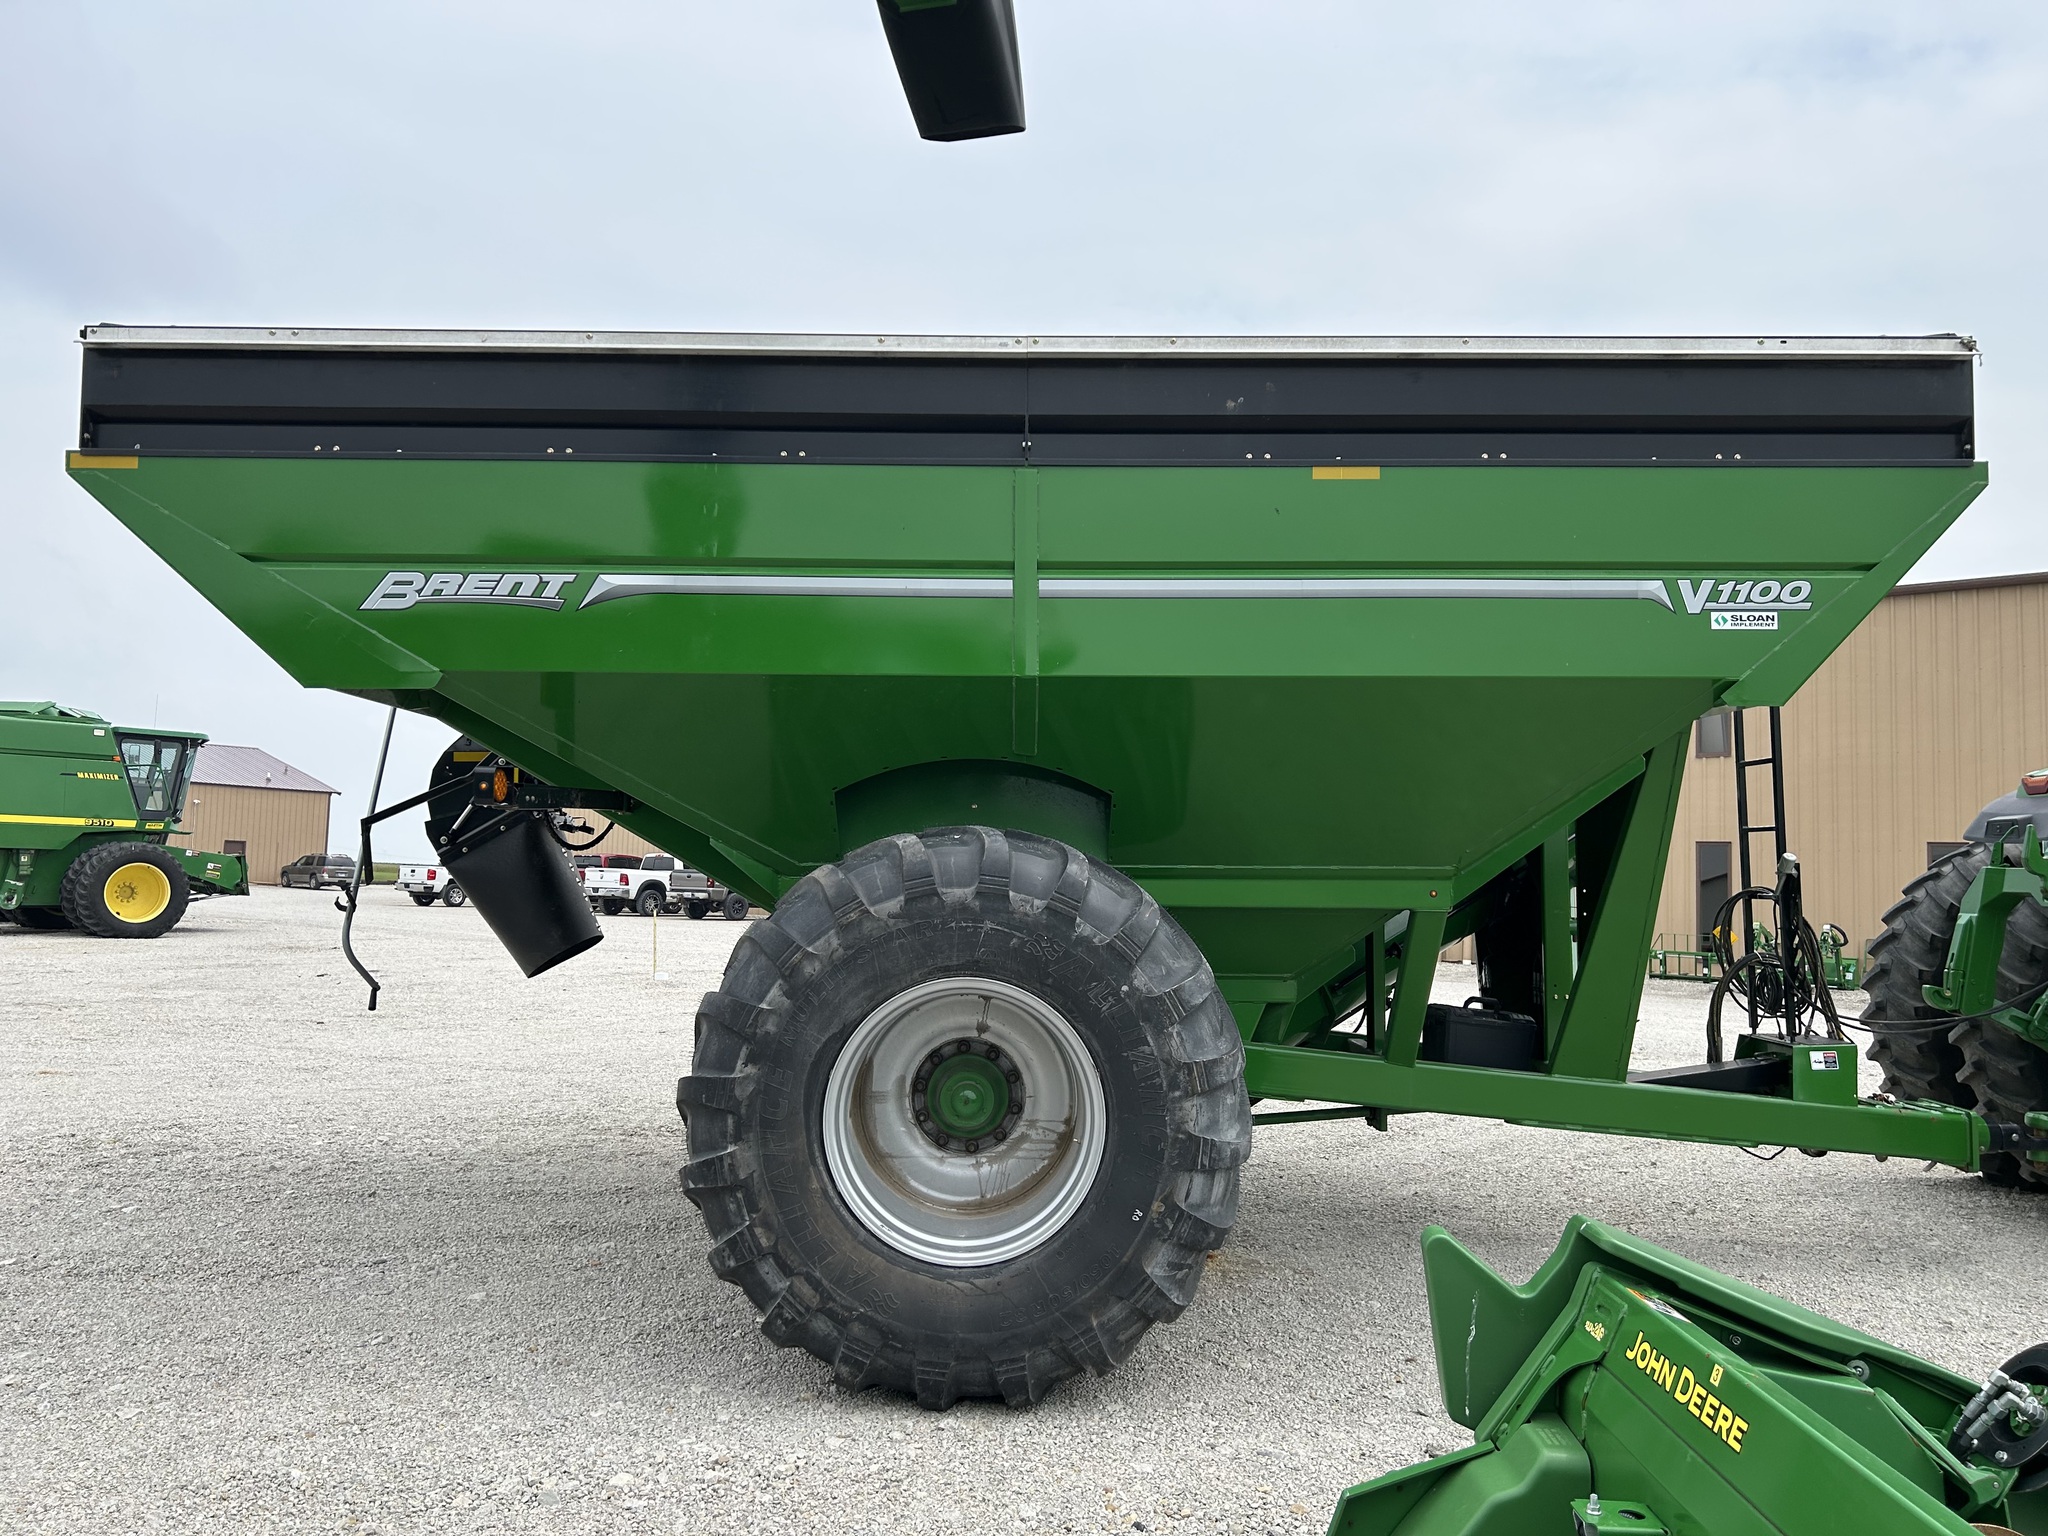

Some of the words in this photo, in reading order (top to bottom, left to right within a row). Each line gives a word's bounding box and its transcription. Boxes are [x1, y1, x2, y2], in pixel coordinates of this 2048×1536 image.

[358, 571, 578, 610] BRENT
[1677, 579, 1812, 615] V1100
[1730, 614, 1775, 622] SLOAN
[76, 771, 119, 781] MAXIMIZER
[84, 818, 114, 828] 9510
[1712, 1367, 1720, 1383] 3
[1625, 1330, 1679, 1394] JOHN
[1674, 1365, 1750, 1454] DEERE
